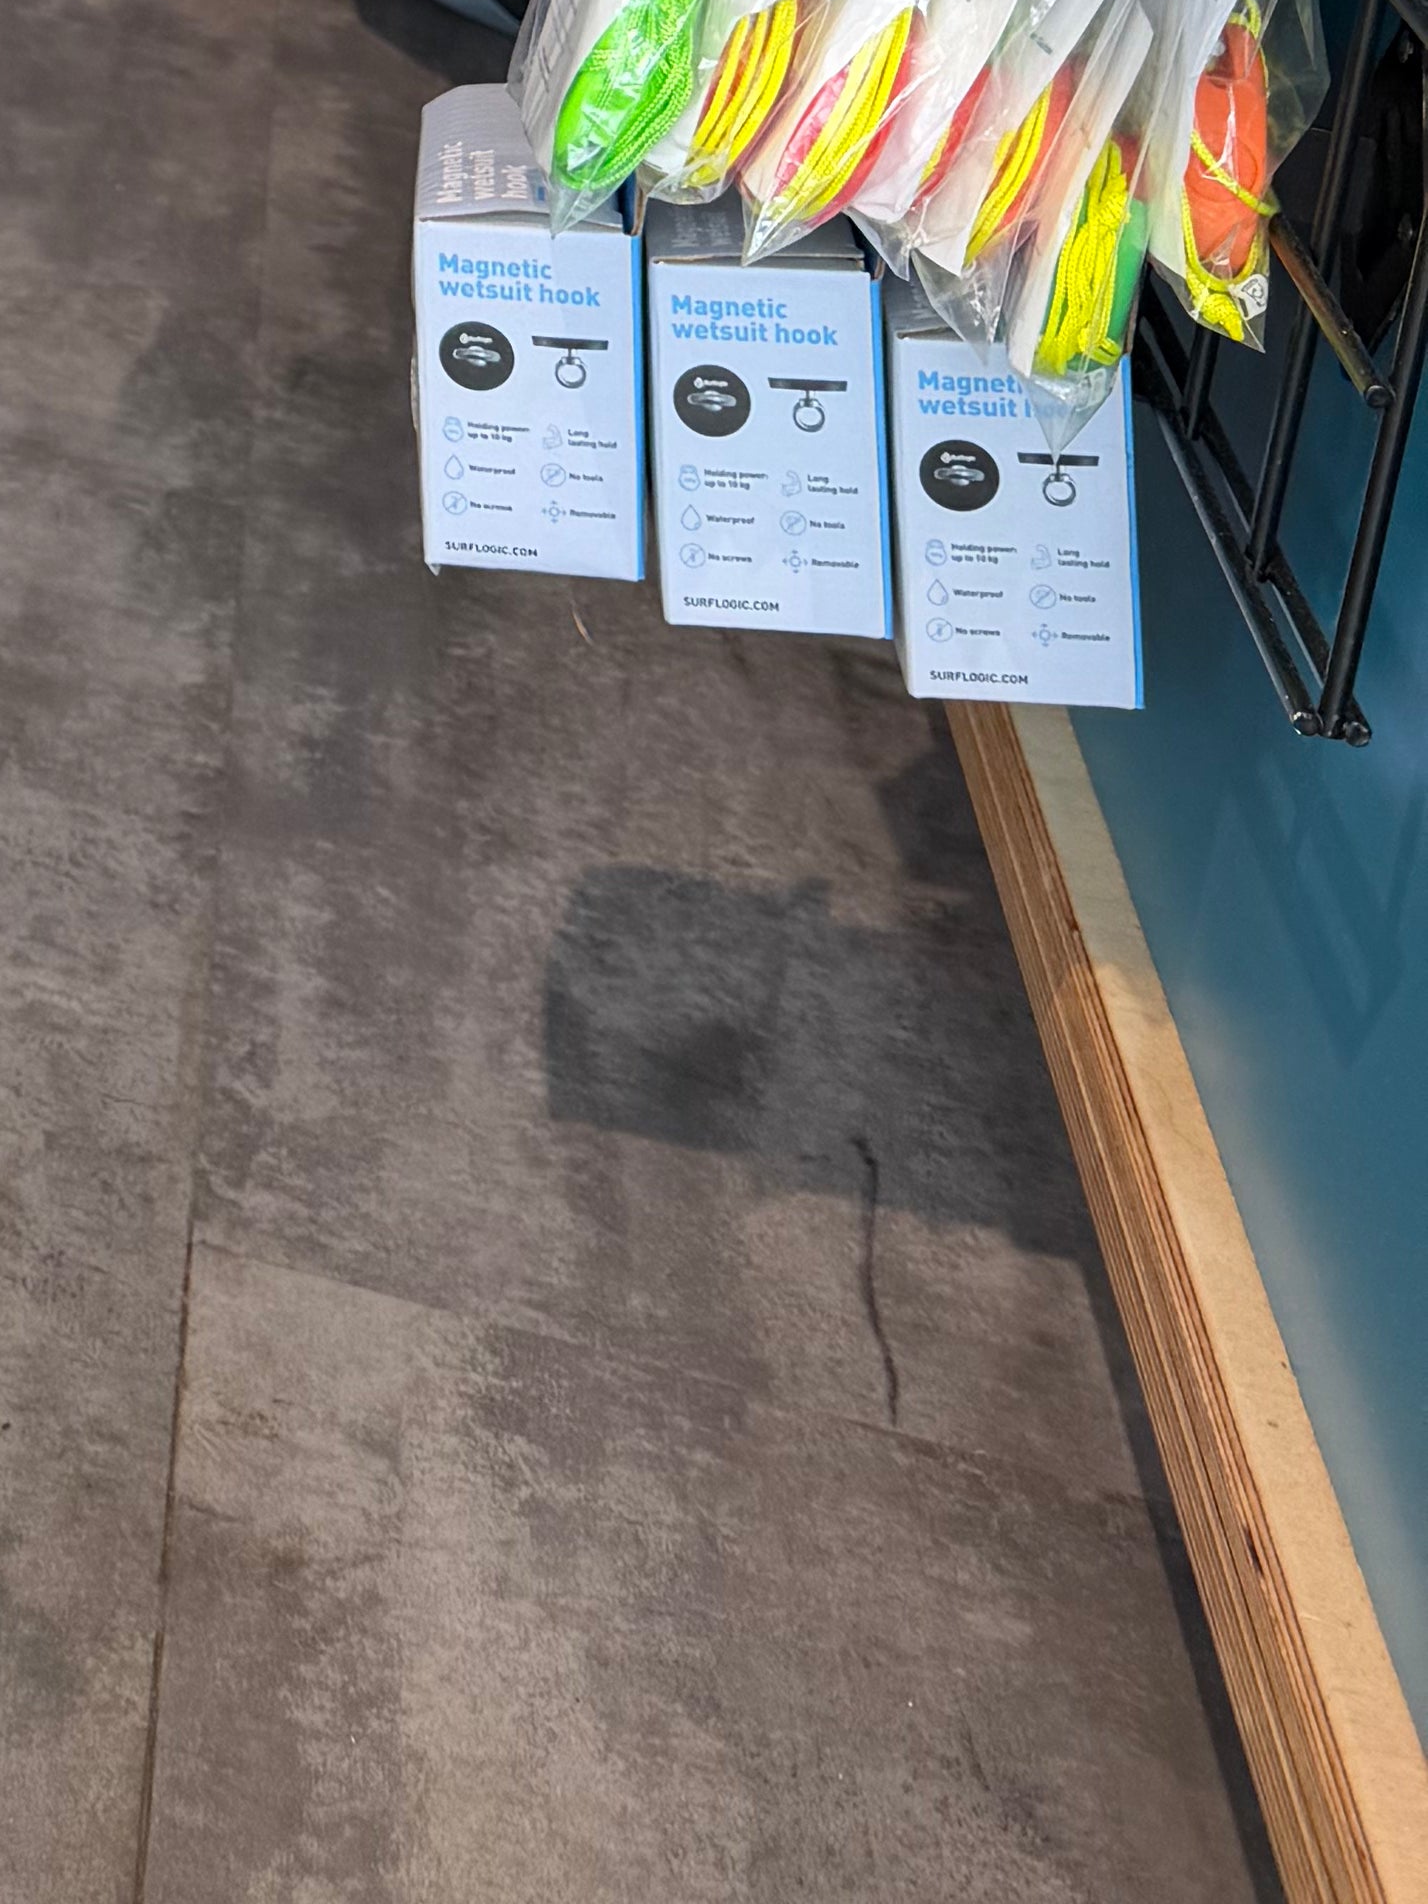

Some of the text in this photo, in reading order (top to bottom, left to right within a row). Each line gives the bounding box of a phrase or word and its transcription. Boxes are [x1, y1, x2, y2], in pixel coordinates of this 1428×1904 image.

[438, 252, 552, 279] Magnetic
[438, 280, 601, 307] wetsuit hook
[671, 294, 788, 320] Magnetic
[672, 322, 838, 346] wetsuit hook
[918, 397, 1018, 418] wetsuit
[444, 541, 538, 557] SURFLOGIC.COM
[683, 596, 780, 612] SURFLOGIC.COM
[929, 669, 1029, 685] SURFLOGIC.COM
